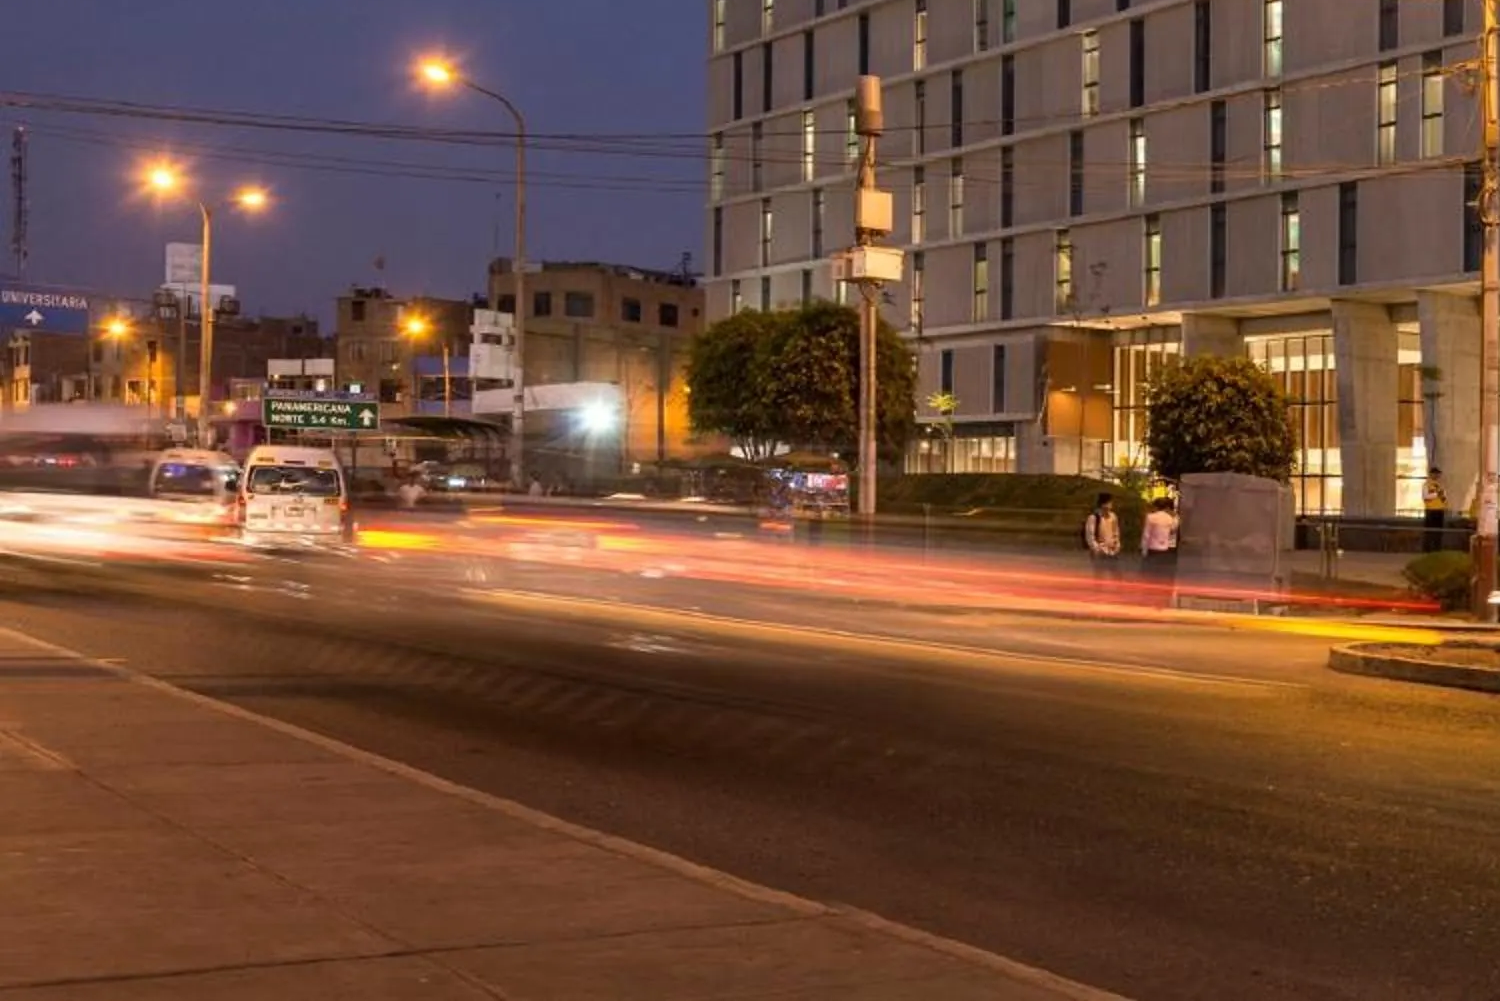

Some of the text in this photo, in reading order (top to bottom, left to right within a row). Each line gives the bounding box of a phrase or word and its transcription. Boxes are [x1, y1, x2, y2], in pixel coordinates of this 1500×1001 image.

[1, 290, 88, 310] UNIVERSITARIA
[271, 401, 352, 414] PANAMERICANA
[271, 414, 304, 424] NORTE
